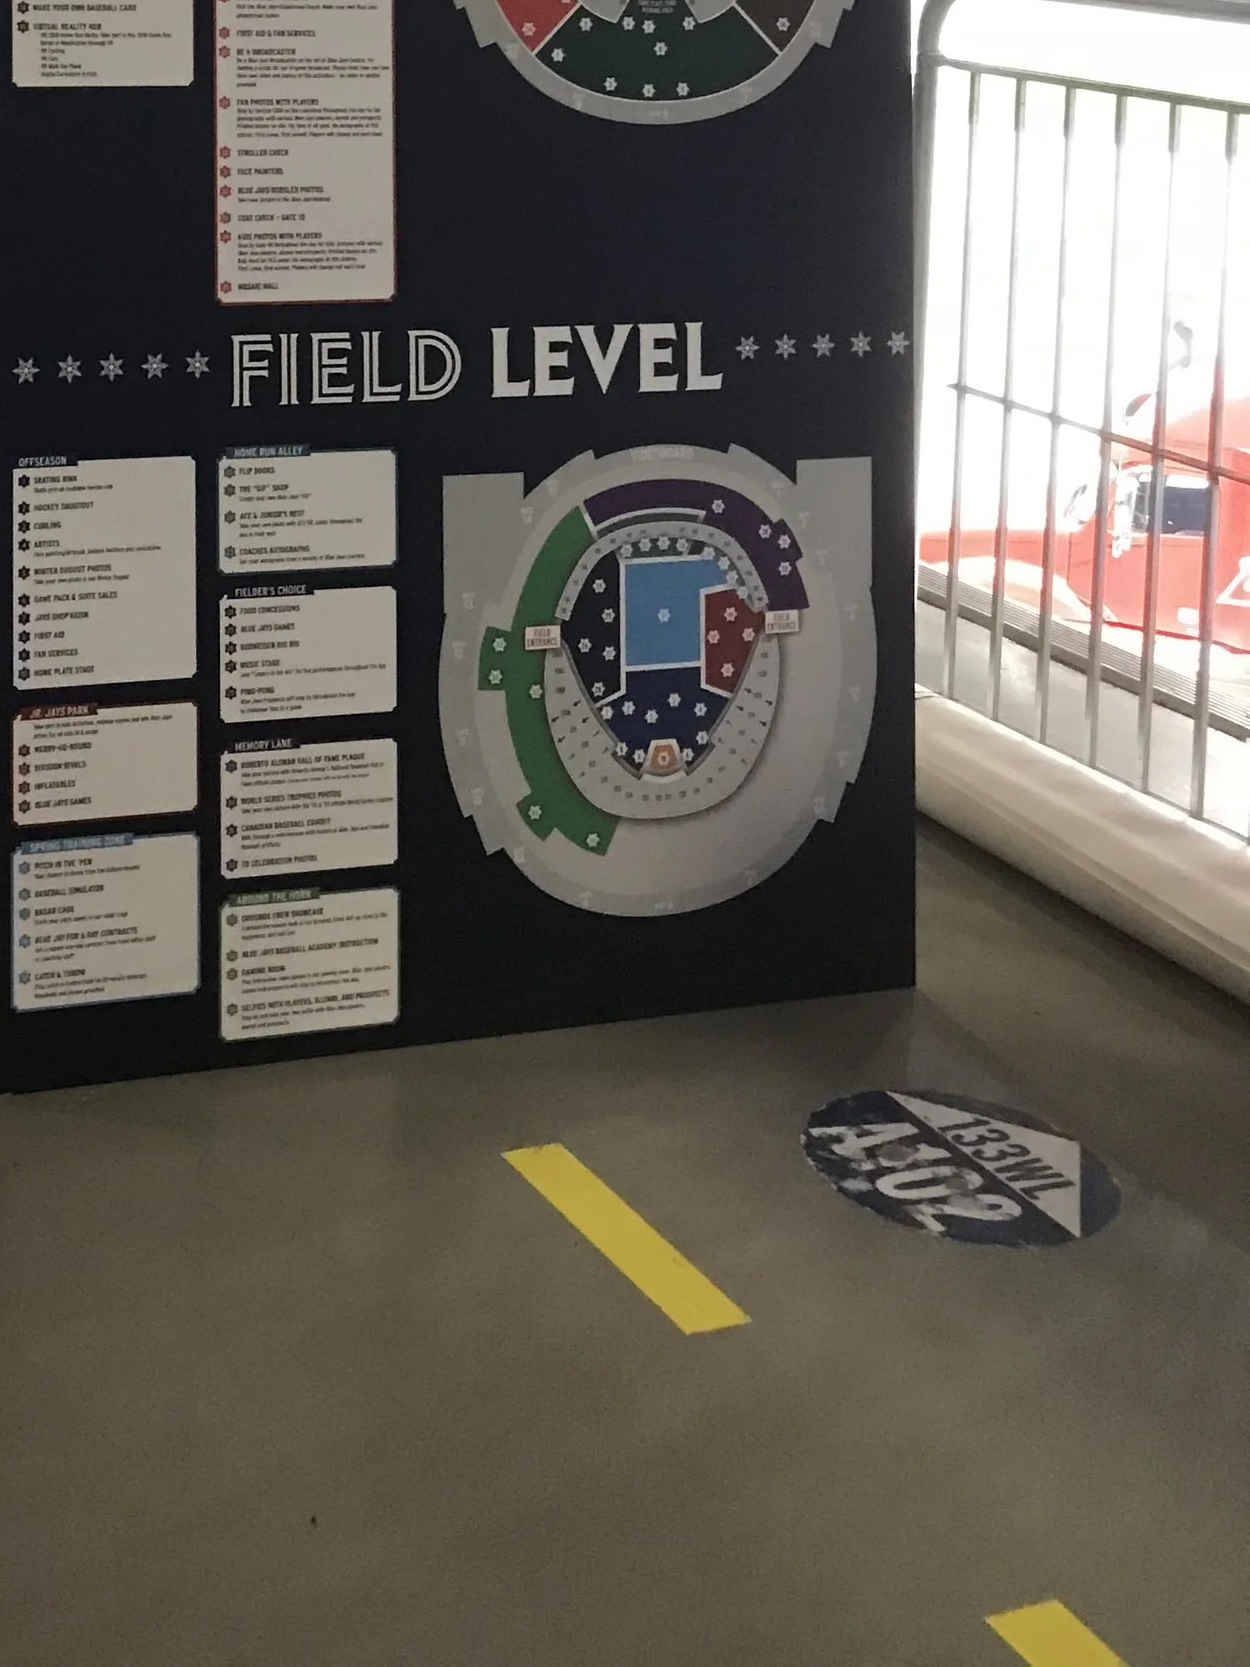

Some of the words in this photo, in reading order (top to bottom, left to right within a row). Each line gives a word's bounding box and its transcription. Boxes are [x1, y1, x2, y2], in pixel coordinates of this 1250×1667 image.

[230, 329, 463, 407] FIELD
[491, 323, 723, 399] LEVEL
[234, 447, 257, 456] HOME
[260, 447, 275, 456] RUN
[278, 446, 303, 456] ALLEY
[19, 456, 67, 467] OFFSEASON
[235, 586, 275, 597] FIELDER'S
[278, 584, 306, 595] CHOICE
[30, 708, 42, 719] JR.
[45, 707, 66, 718] JAYS
[68, 706, 89, 716] PARK
[235, 740, 269, 751] MEMORY
[272, 738, 292, 748] LANE
